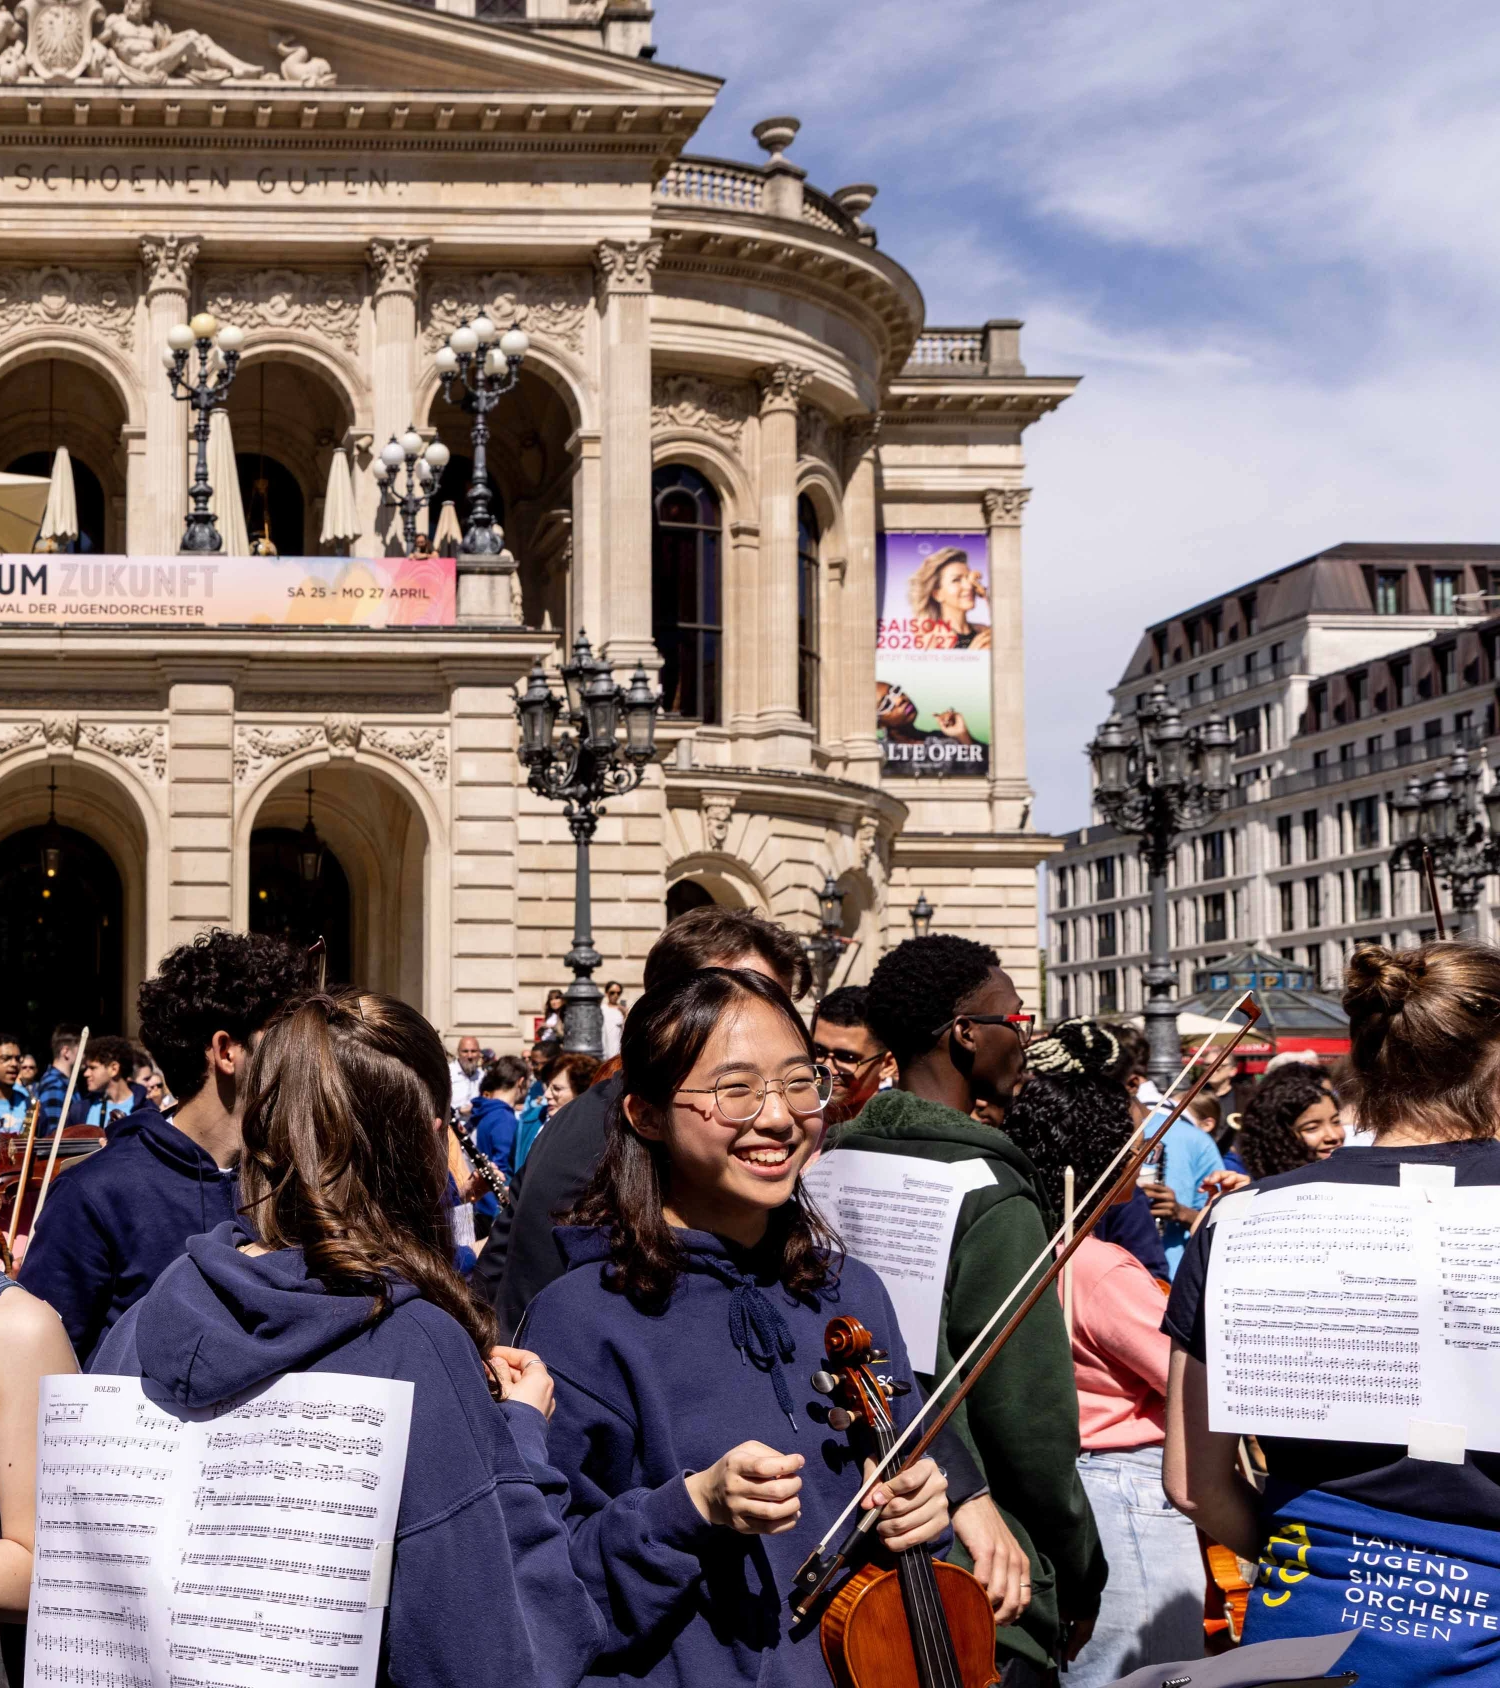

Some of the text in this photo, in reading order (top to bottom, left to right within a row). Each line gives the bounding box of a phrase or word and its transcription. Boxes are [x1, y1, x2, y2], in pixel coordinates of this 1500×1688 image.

[14, 163, 230, 193] SCHOENEN
[58, 564, 219, 599] ZUKUNFT
[287, 587, 306, 599] SA
[311, 587, 326, 599] 25
[342, 587, 365, 599] MO
[370, 587, 385, 599] 27
[390, 588, 431, 600] APRIL
[29, 603, 57, 615] DER
[61, 603, 205, 617] JUGENDORCHESTER
[877, 617, 952, 634] SAISON
[877, 635, 959, 651] 2026/27
[879, 743, 983, 762] LTE OPER
[93, 1385, 122, 1394] BOLERO
[1347, 1551, 1469, 1581] JUGEND
[1349, 1569, 1490, 1609] SINFONIE
[1345, 1587, 1499, 1630] ORCHESTE
[1341, 1607, 1451, 1642] HESSEN
